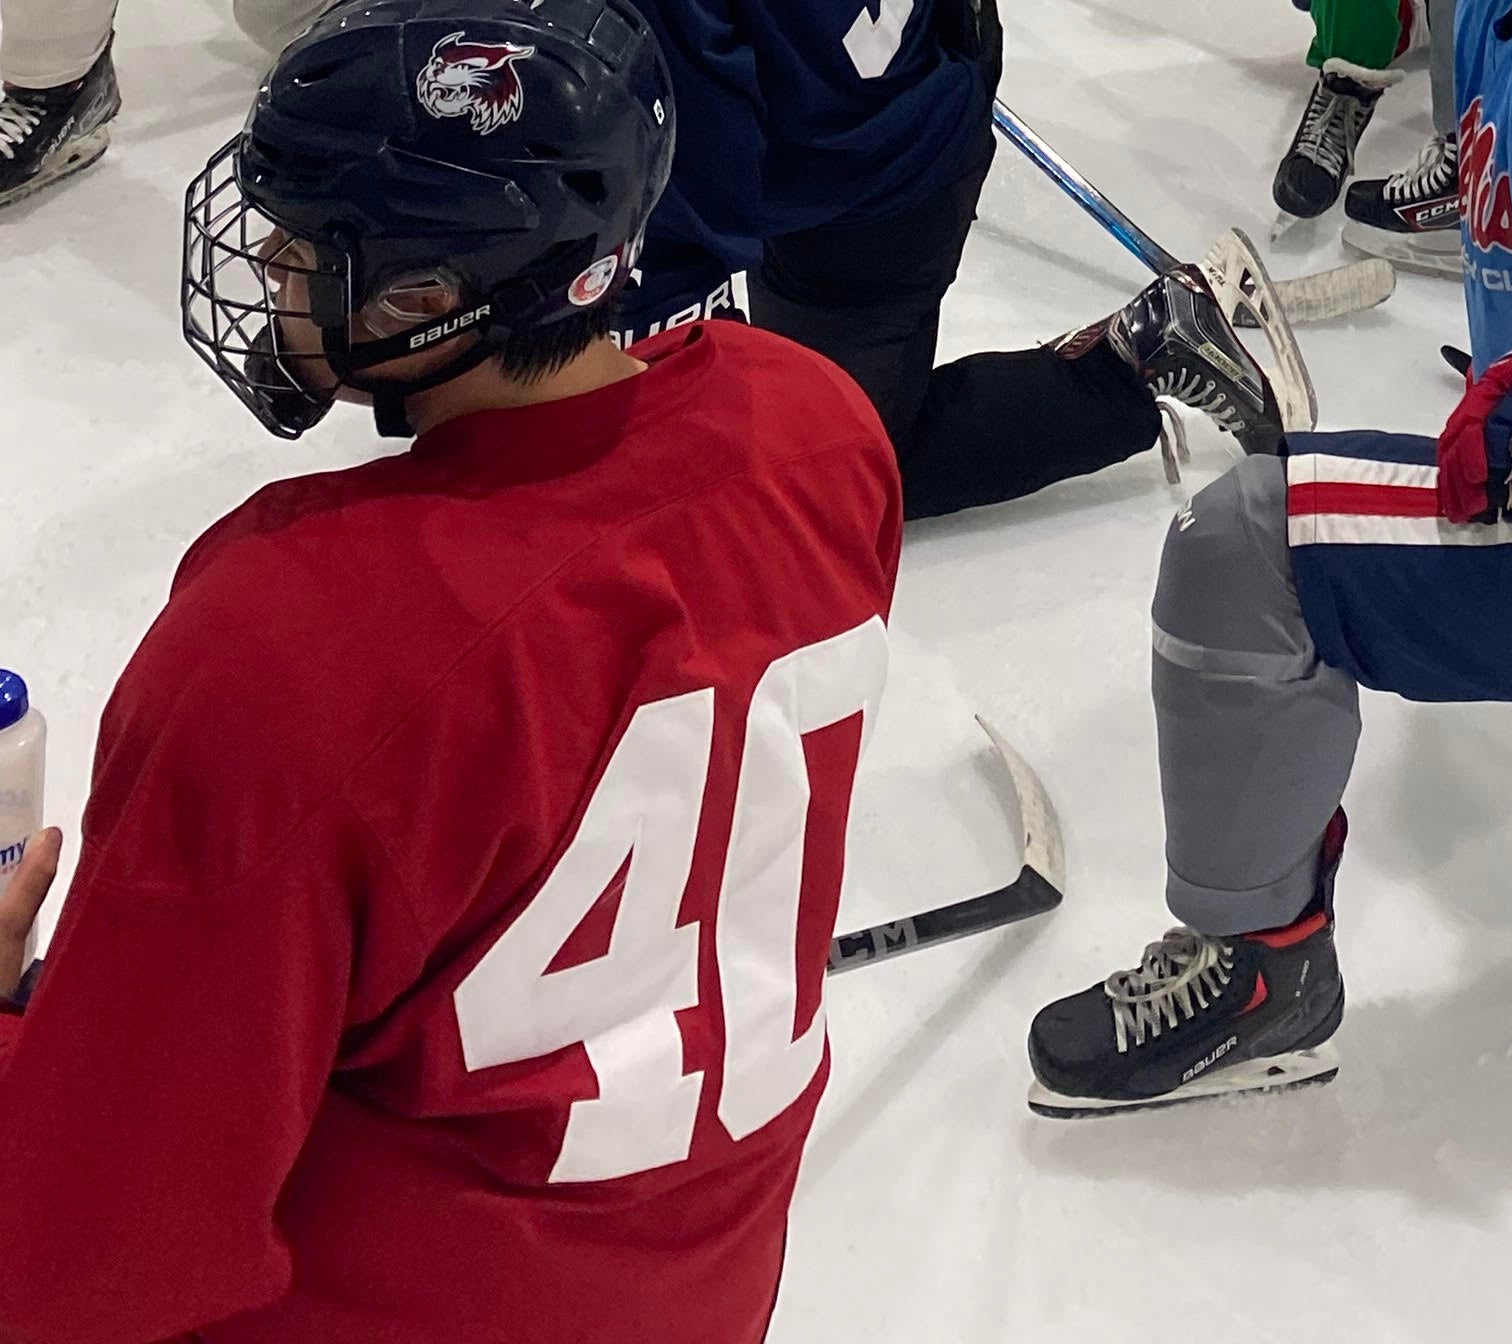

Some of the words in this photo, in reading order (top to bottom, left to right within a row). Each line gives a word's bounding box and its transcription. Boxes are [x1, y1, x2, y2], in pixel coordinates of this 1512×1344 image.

[1415, 199, 1461, 223] CCM
[409, 303, 492, 351] BAUER
[452, 612, 890, 1185] 40
[829, 914, 919, 974] CM
[1181, 1035, 1238, 1084] BAUER
